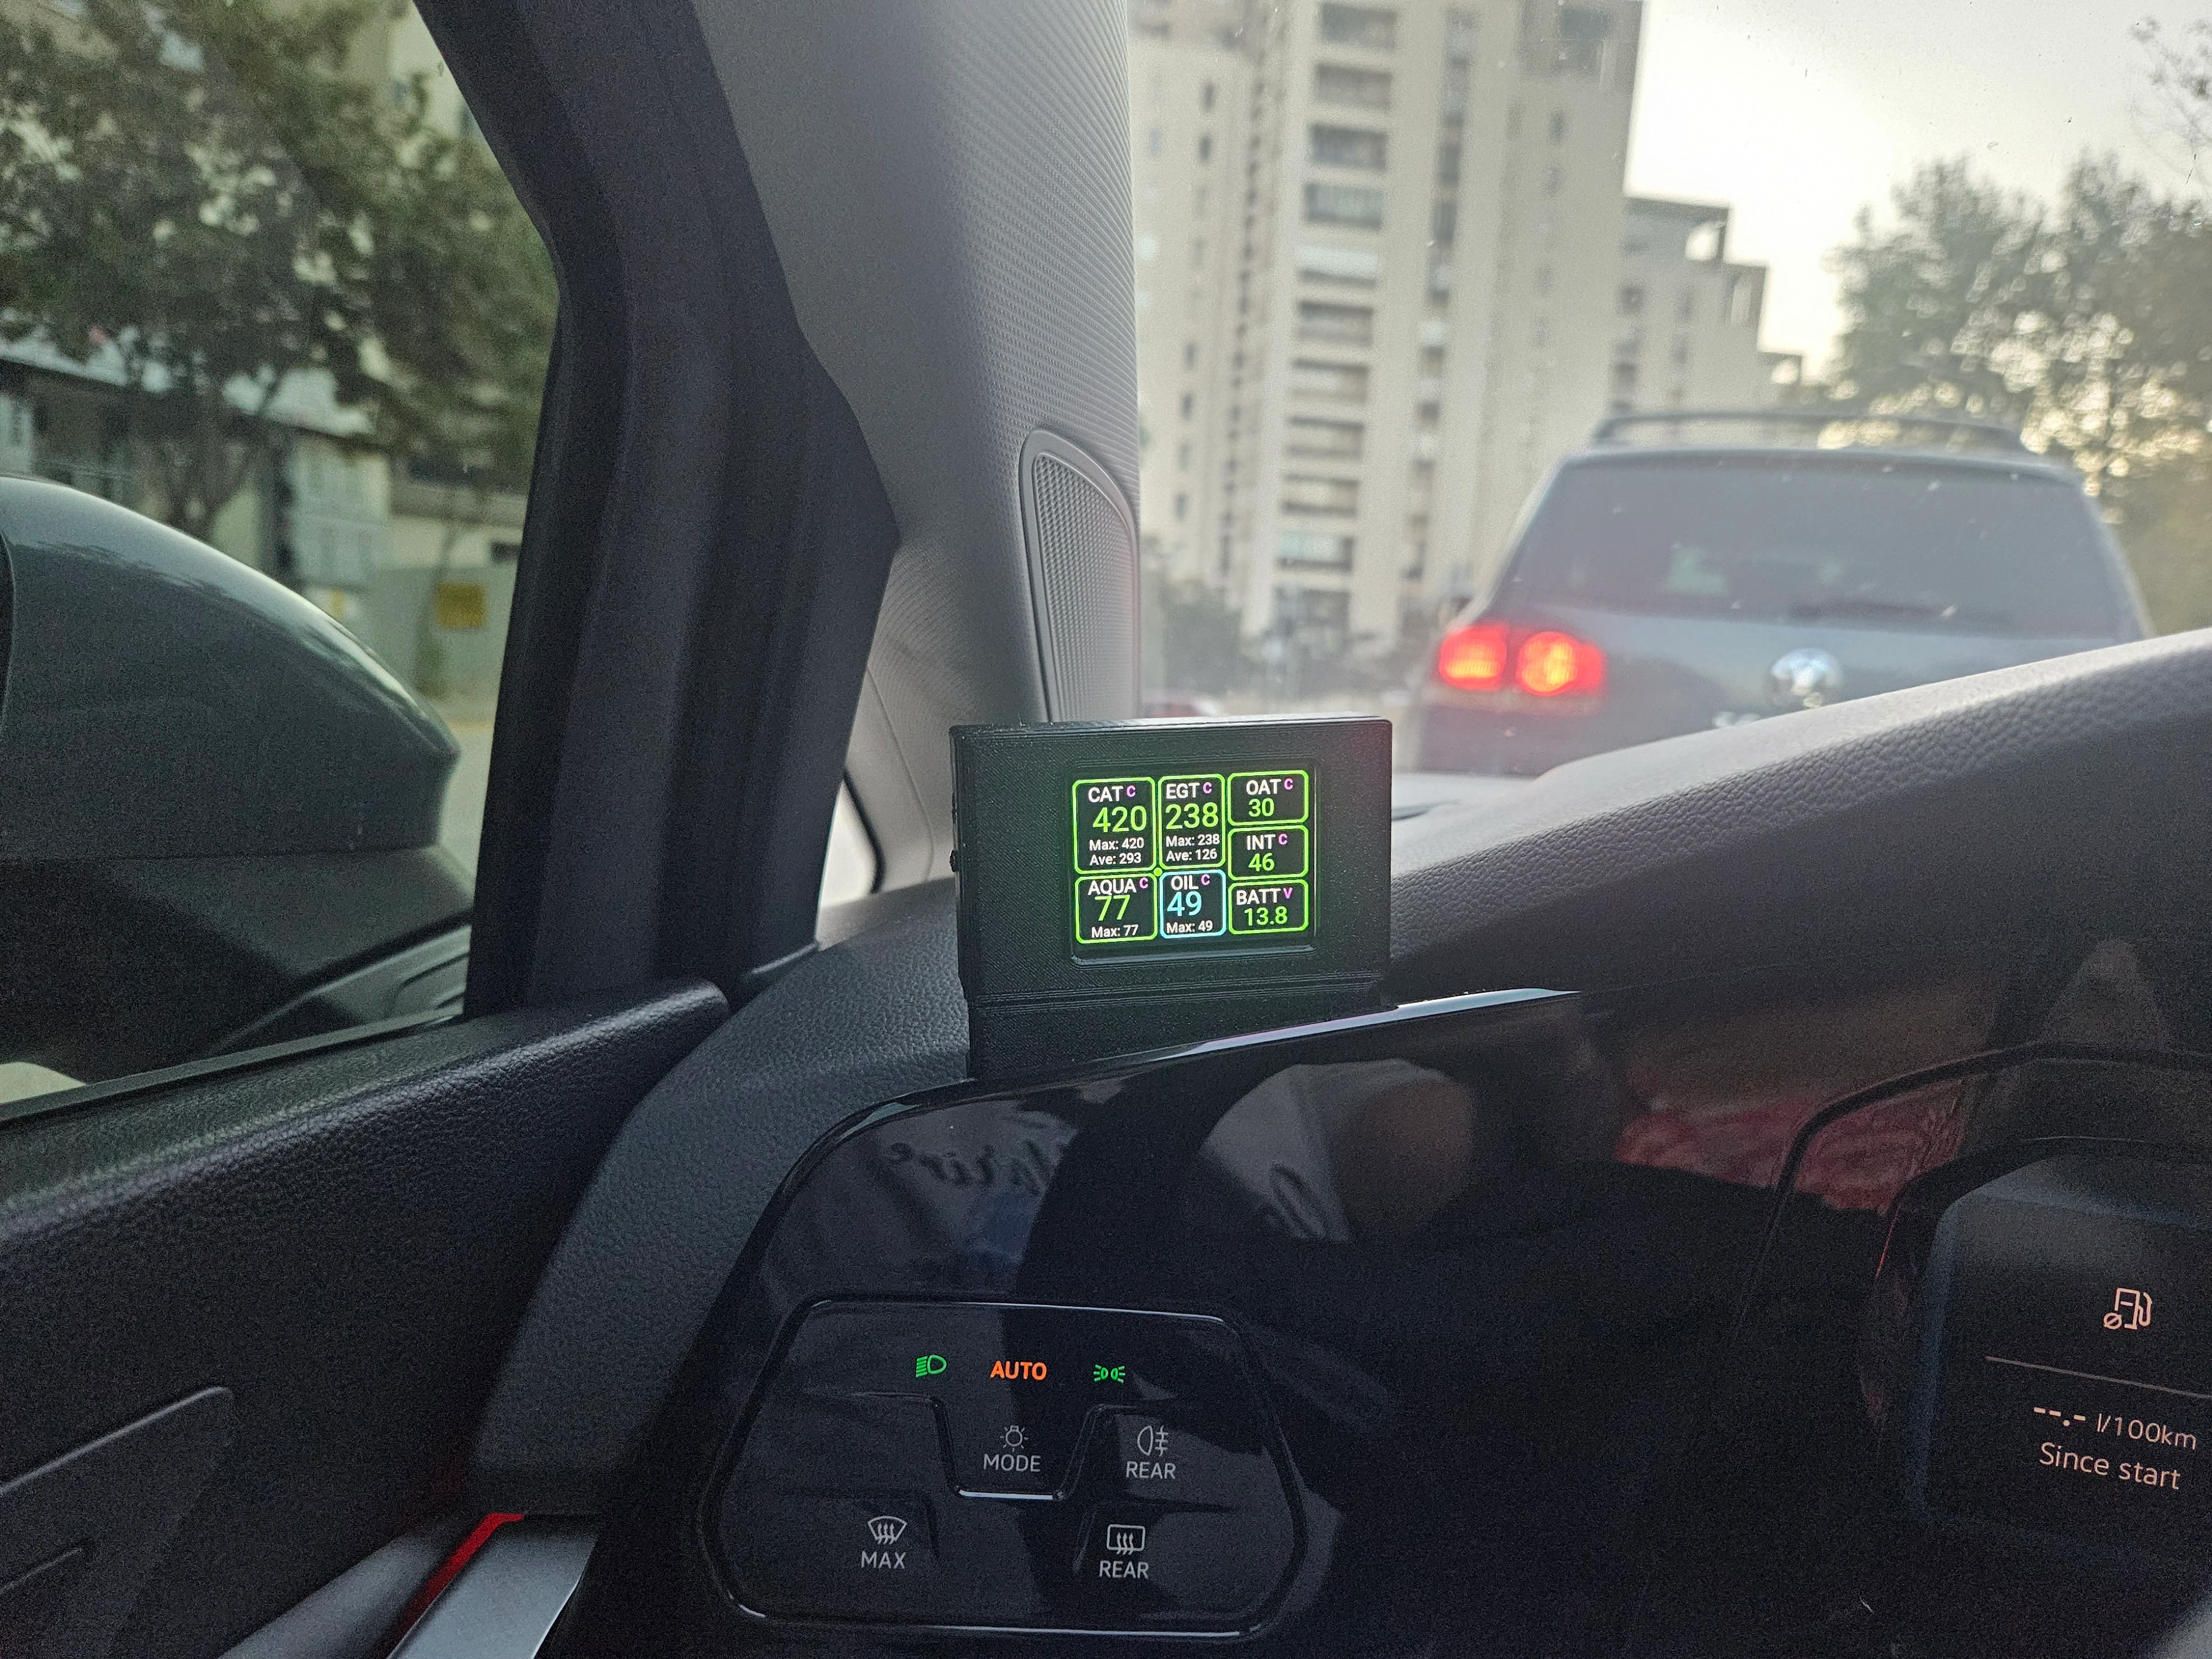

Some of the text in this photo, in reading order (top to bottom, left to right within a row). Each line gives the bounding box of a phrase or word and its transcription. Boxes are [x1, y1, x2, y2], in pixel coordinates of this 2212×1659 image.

[1088, 785, 1136, 802] CAT C
[1166, 782, 1212, 799] EGT C
[1246, 779, 1293, 795] OAT C
[1165, 802, 1218, 830] 238
[1249, 799, 1274, 817] 30
[1093, 806, 1147, 832] 420
[1089, 837, 1144, 851] Max: 420
[1166, 833, 1220, 847] Max: 238
[1247, 833, 1288, 849] INT C
[1089, 853, 1141, 866] Ave: 293
[1166, 849, 1217, 862] Ave: 126
[1249, 853, 1275, 871] 46
[1088, 877, 1149, 895] AQUA C
[1171, 874, 1210, 890] OIL C
[1167, 892, 1202, 916] 49
[1237, 888, 1292, 905] BATT V
[1094, 895, 1130, 921] 77
[1244, 906, 1287, 926] 13.8
[1092, 924, 1139, 937] Max: 77
[1167, 921, 1212, 933] Max: 49
[990, 1361, 1047, 1380] AUTO
[984, 1454, 1041, 1472] MODE
[1127, 1462, 1176, 1479] REAR
[2039, 1442, 2181, 1490] Since start
[861, 1552, 906, 1569] MAX
[1099, 1561, 1149, 1578] REAR
